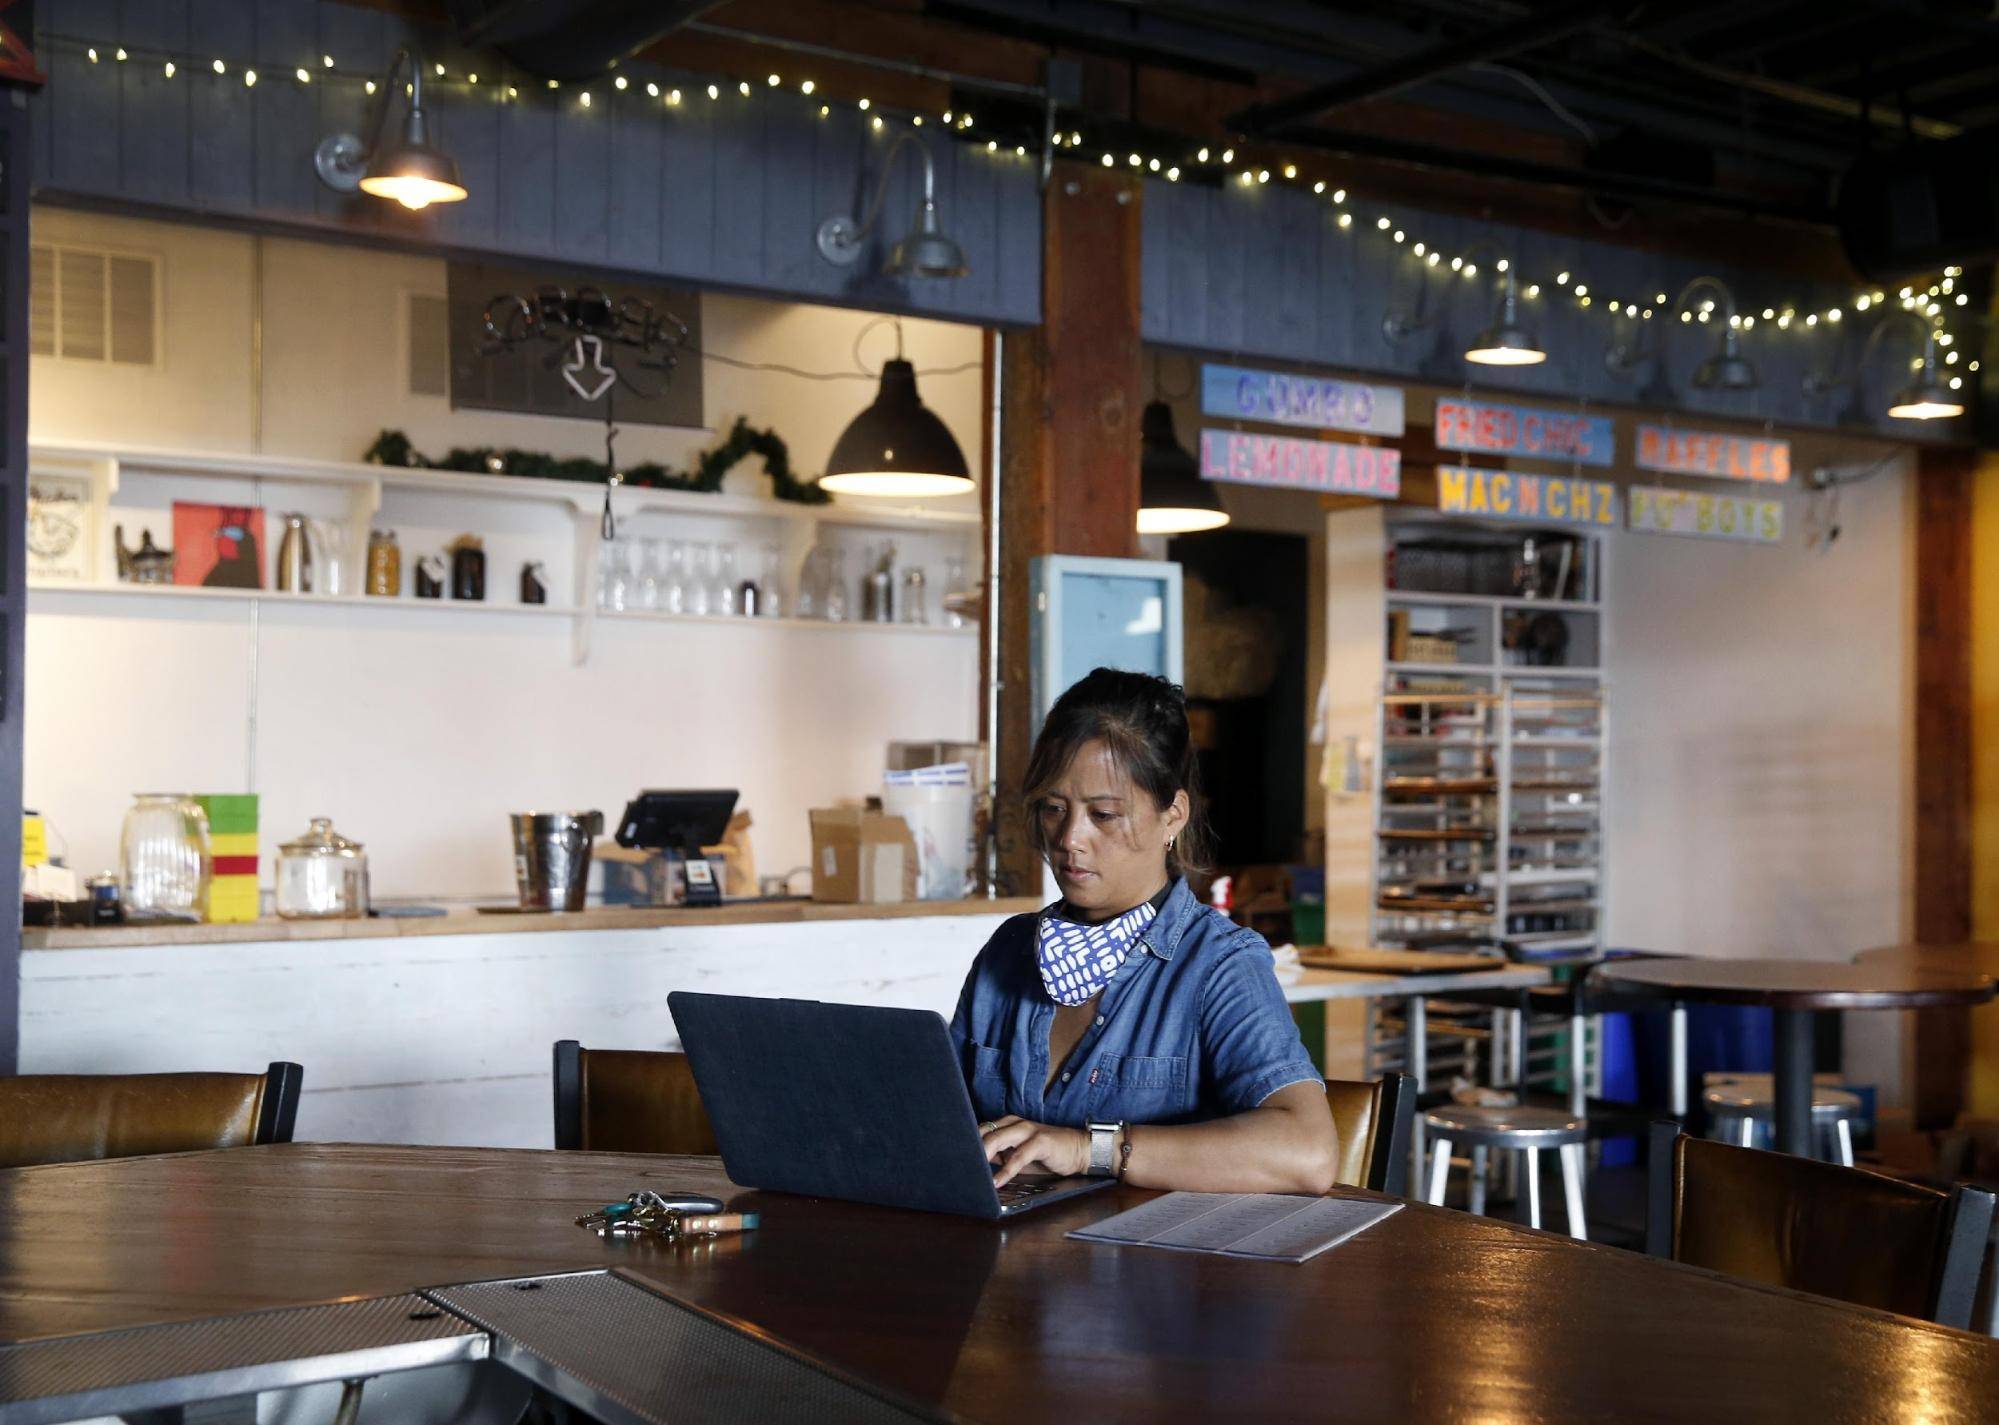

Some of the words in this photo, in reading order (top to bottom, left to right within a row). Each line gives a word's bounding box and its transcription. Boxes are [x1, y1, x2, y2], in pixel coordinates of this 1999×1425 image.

[1236, 373, 1375, 425] GUMBO
[1438, 403, 1519, 449] FRIED
[1201, 432, 1400, 493] LEMONADE
[1439, 469, 1512, 513] MAC
[1518, 475, 1540, 517] N
[1546, 479, 1615, 525] CHZ
